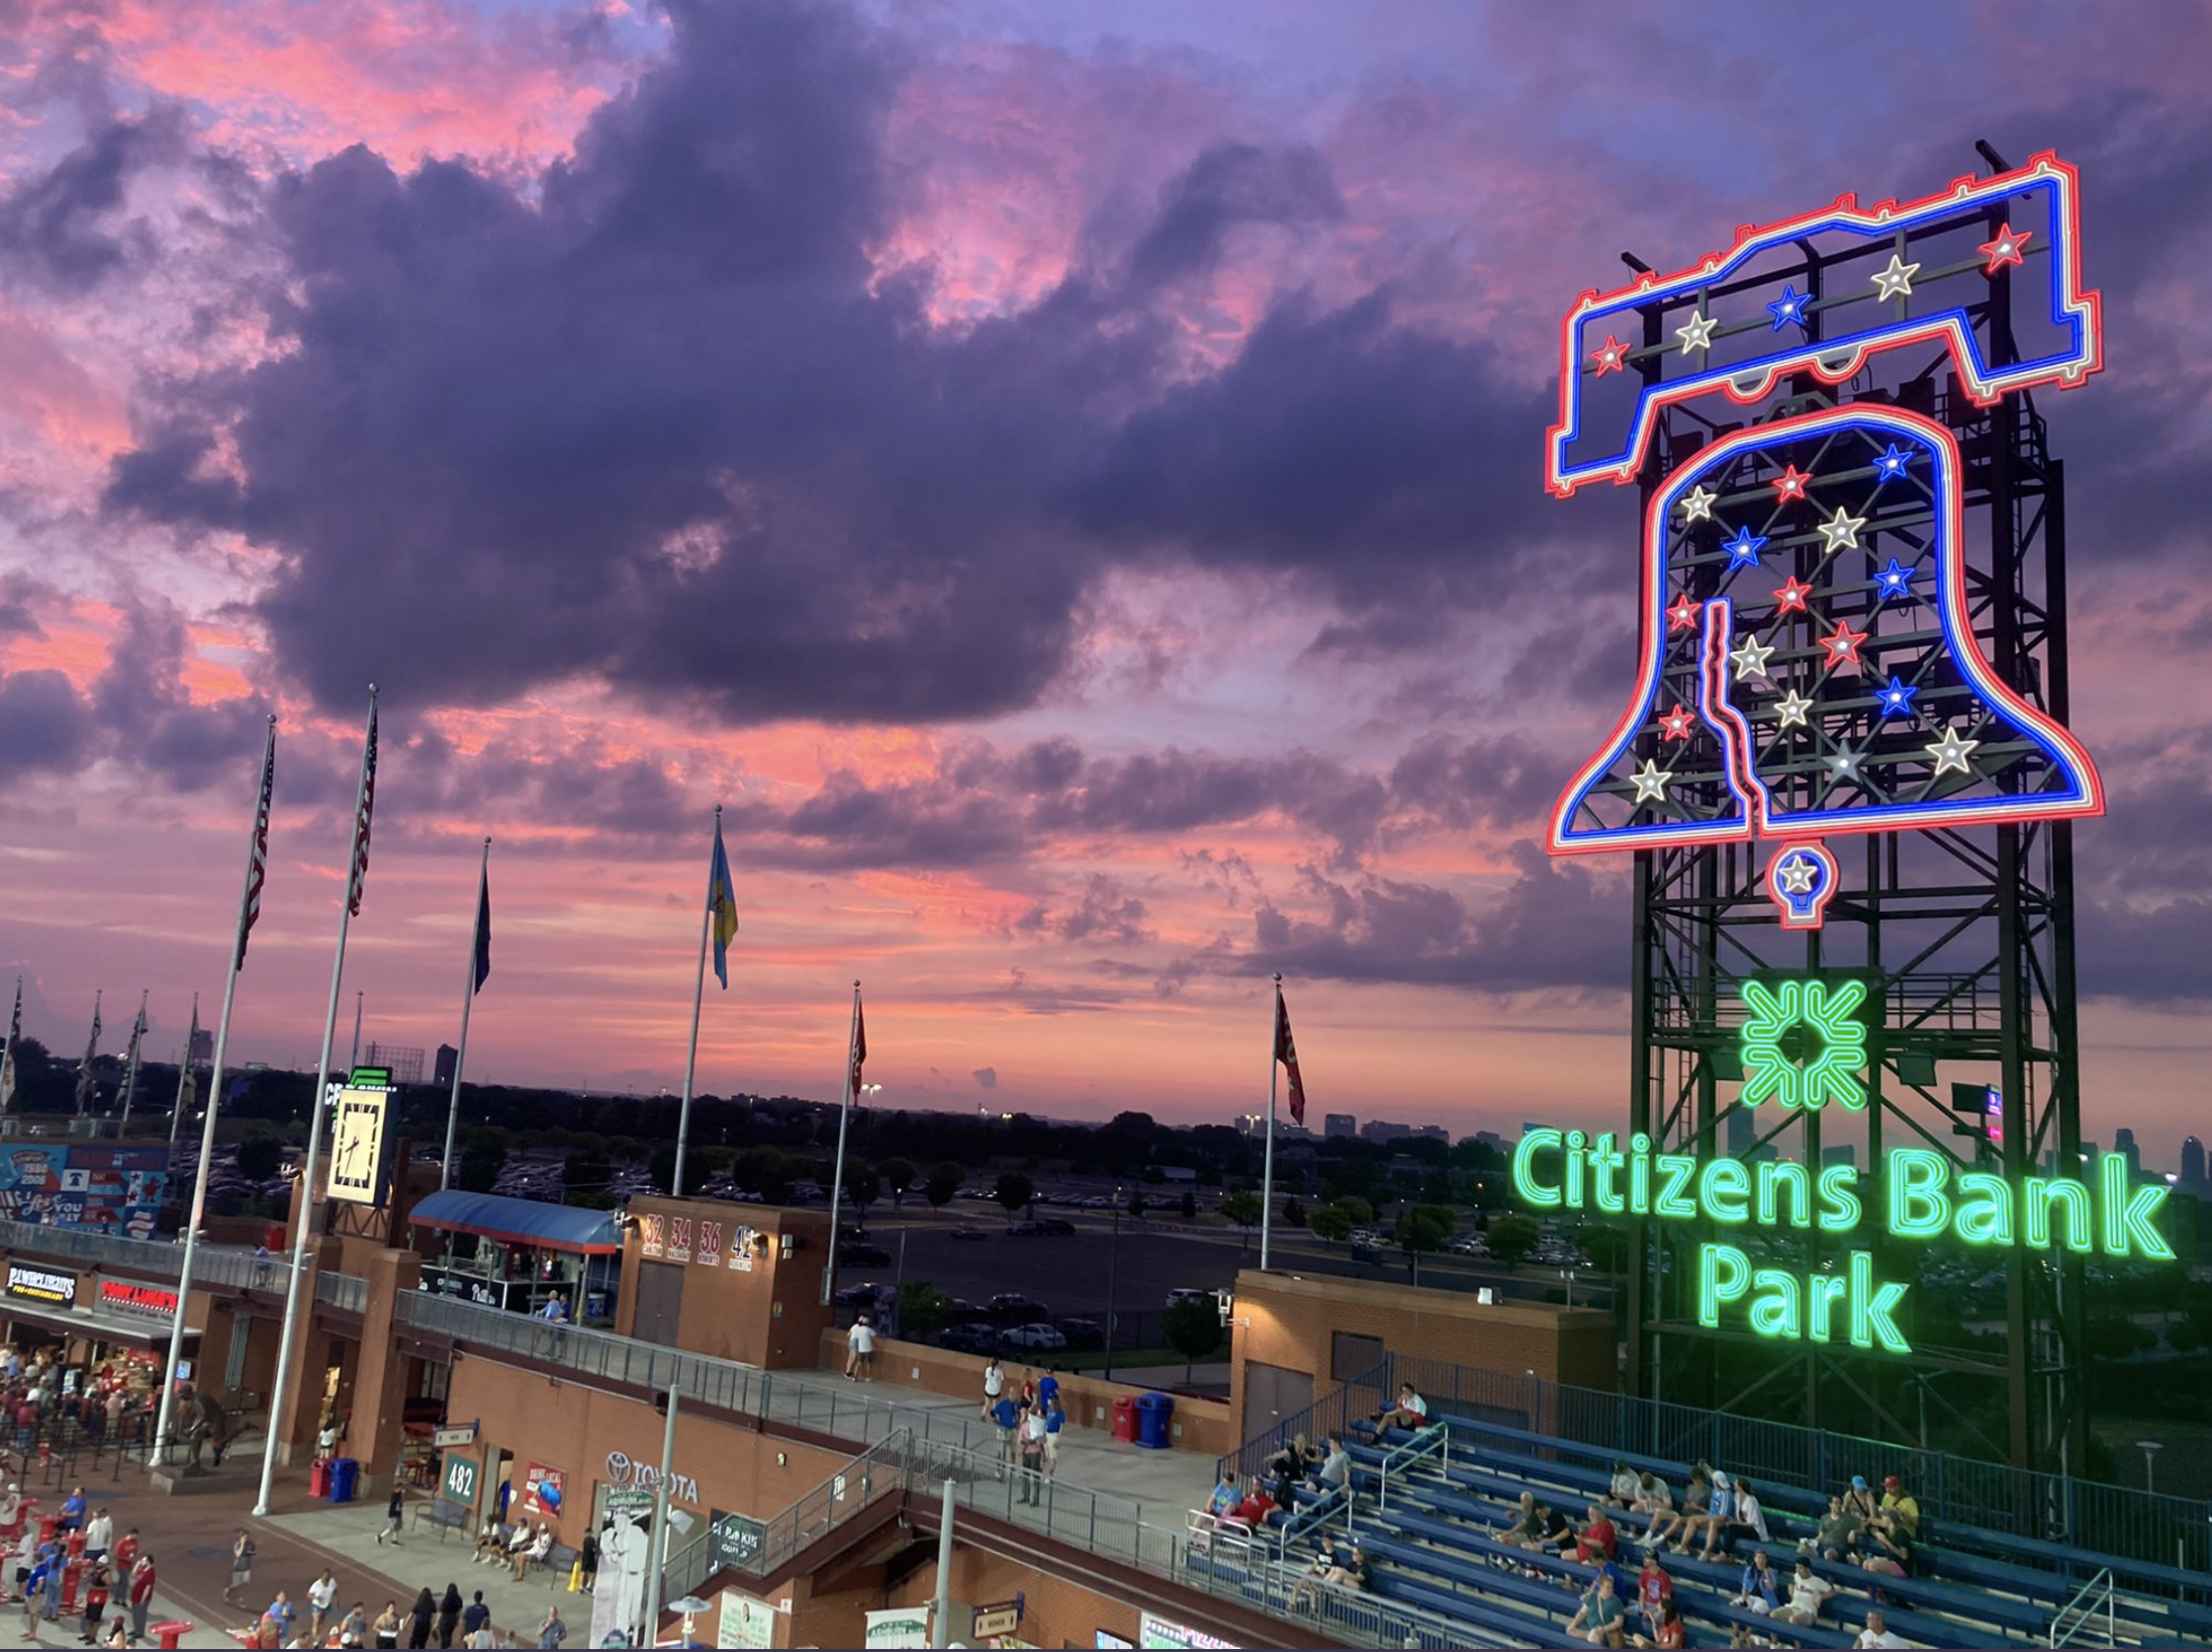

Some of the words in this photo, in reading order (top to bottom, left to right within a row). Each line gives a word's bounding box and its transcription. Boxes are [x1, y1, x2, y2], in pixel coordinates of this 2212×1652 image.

[1513, 1128, 1862, 1233] Citizens
[1888, 1147, 2176, 1260] Bank
[644, 1213, 665, 1245] 32
[671, 1217, 691, 1249] 34
[700, 1221, 722, 1254] 36
[1699, 1242, 1910, 1353] Park
[448, 1463, 473, 1497] 482
